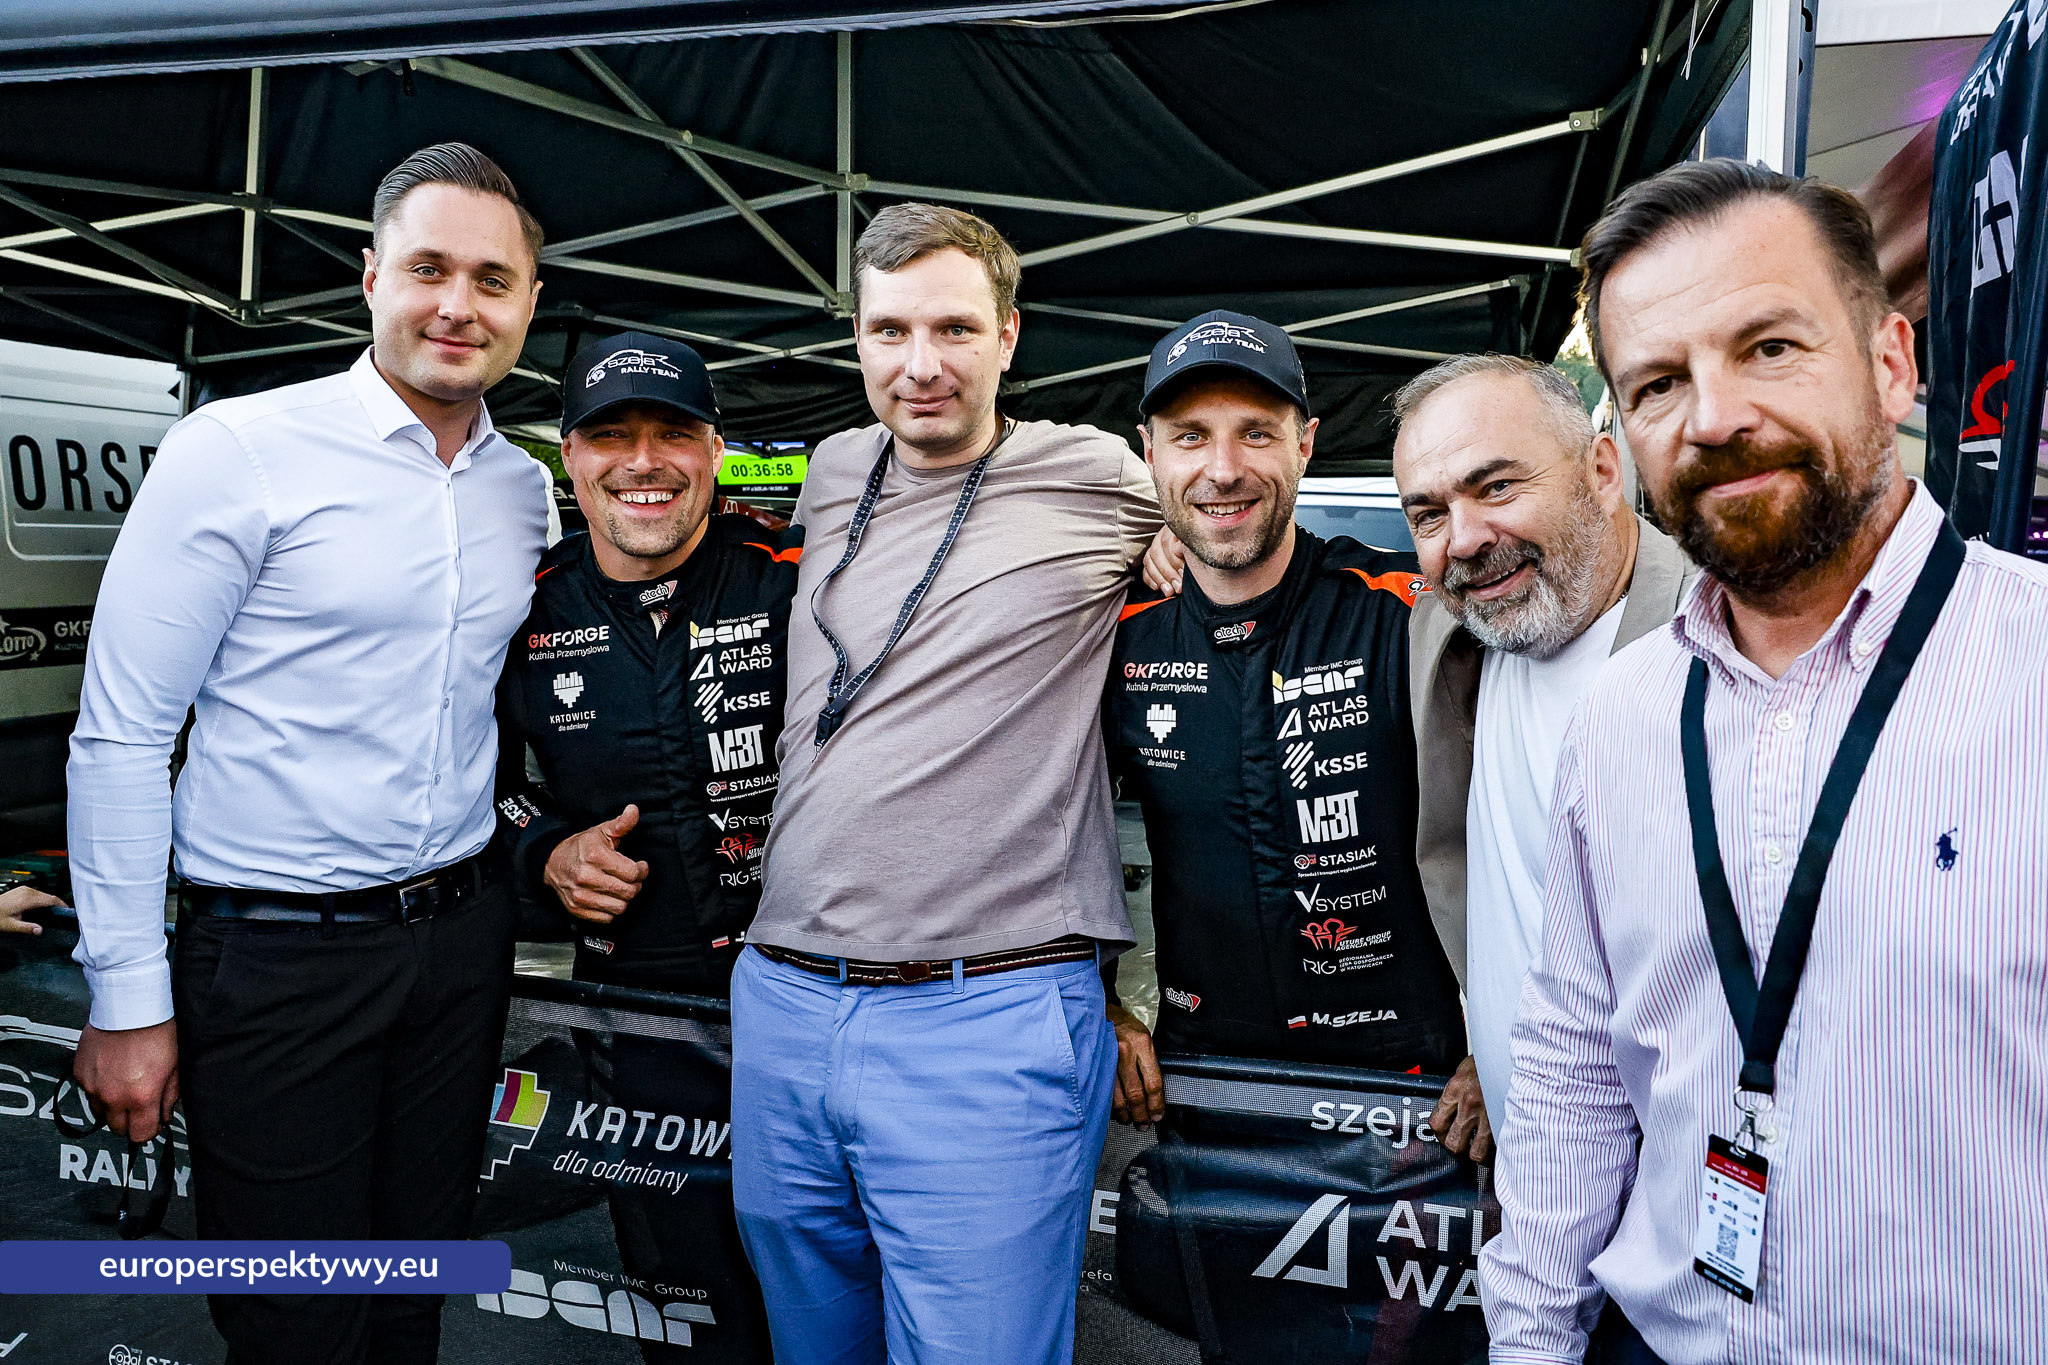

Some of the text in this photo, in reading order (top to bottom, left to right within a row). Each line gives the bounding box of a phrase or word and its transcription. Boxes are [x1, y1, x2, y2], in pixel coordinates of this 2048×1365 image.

[1203, 337, 1266, 354] RALLY TEAM
[620, 366, 679, 380] RALLY TEAM
[731, 463, 794, 477] 00:36:58
[716, 617, 739, 625] Member
[751, 612, 769, 620] Group
[0, 635, 34, 653] OTTO
[528, 625, 610, 649] GKFORGE
[719, 643, 772, 662] ATLAS
[719, 656, 773, 675] WARD
[1124, 661, 1209, 680] GKFORGE
[1304, 657, 1363, 674] Member IMC Group
[723, 690, 772, 713] KSSE
[1308, 694, 1368, 718] ATLAS
[549, 710, 597, 724] KATOWICE
[1308, 710, 1370, 733] WARD
[1138, 747, 1187, 762] KATOWICE
[1314, 751, 1368, 778] KSSE
[729, 772, 779, 792] STASIAK
[1319, 844, 1377, 867] STASIAK
[719, 870, 750, 887] RIG
[1293, 882, 1387, 913] VSYSTEM
[1365, 930, 1391, 943] GROUP
[1369, 934, 1392, 946] PRACY
[1302, 958, 1337, 975] RIG
[1312, 1009, 1398, 1028] M.SZEJA
[566, 1100, 732, 1160] KATOW
[552, 1150, 689, 1196] dla odmiany
[553, 1259, 708, 1300] Member IMC Group
